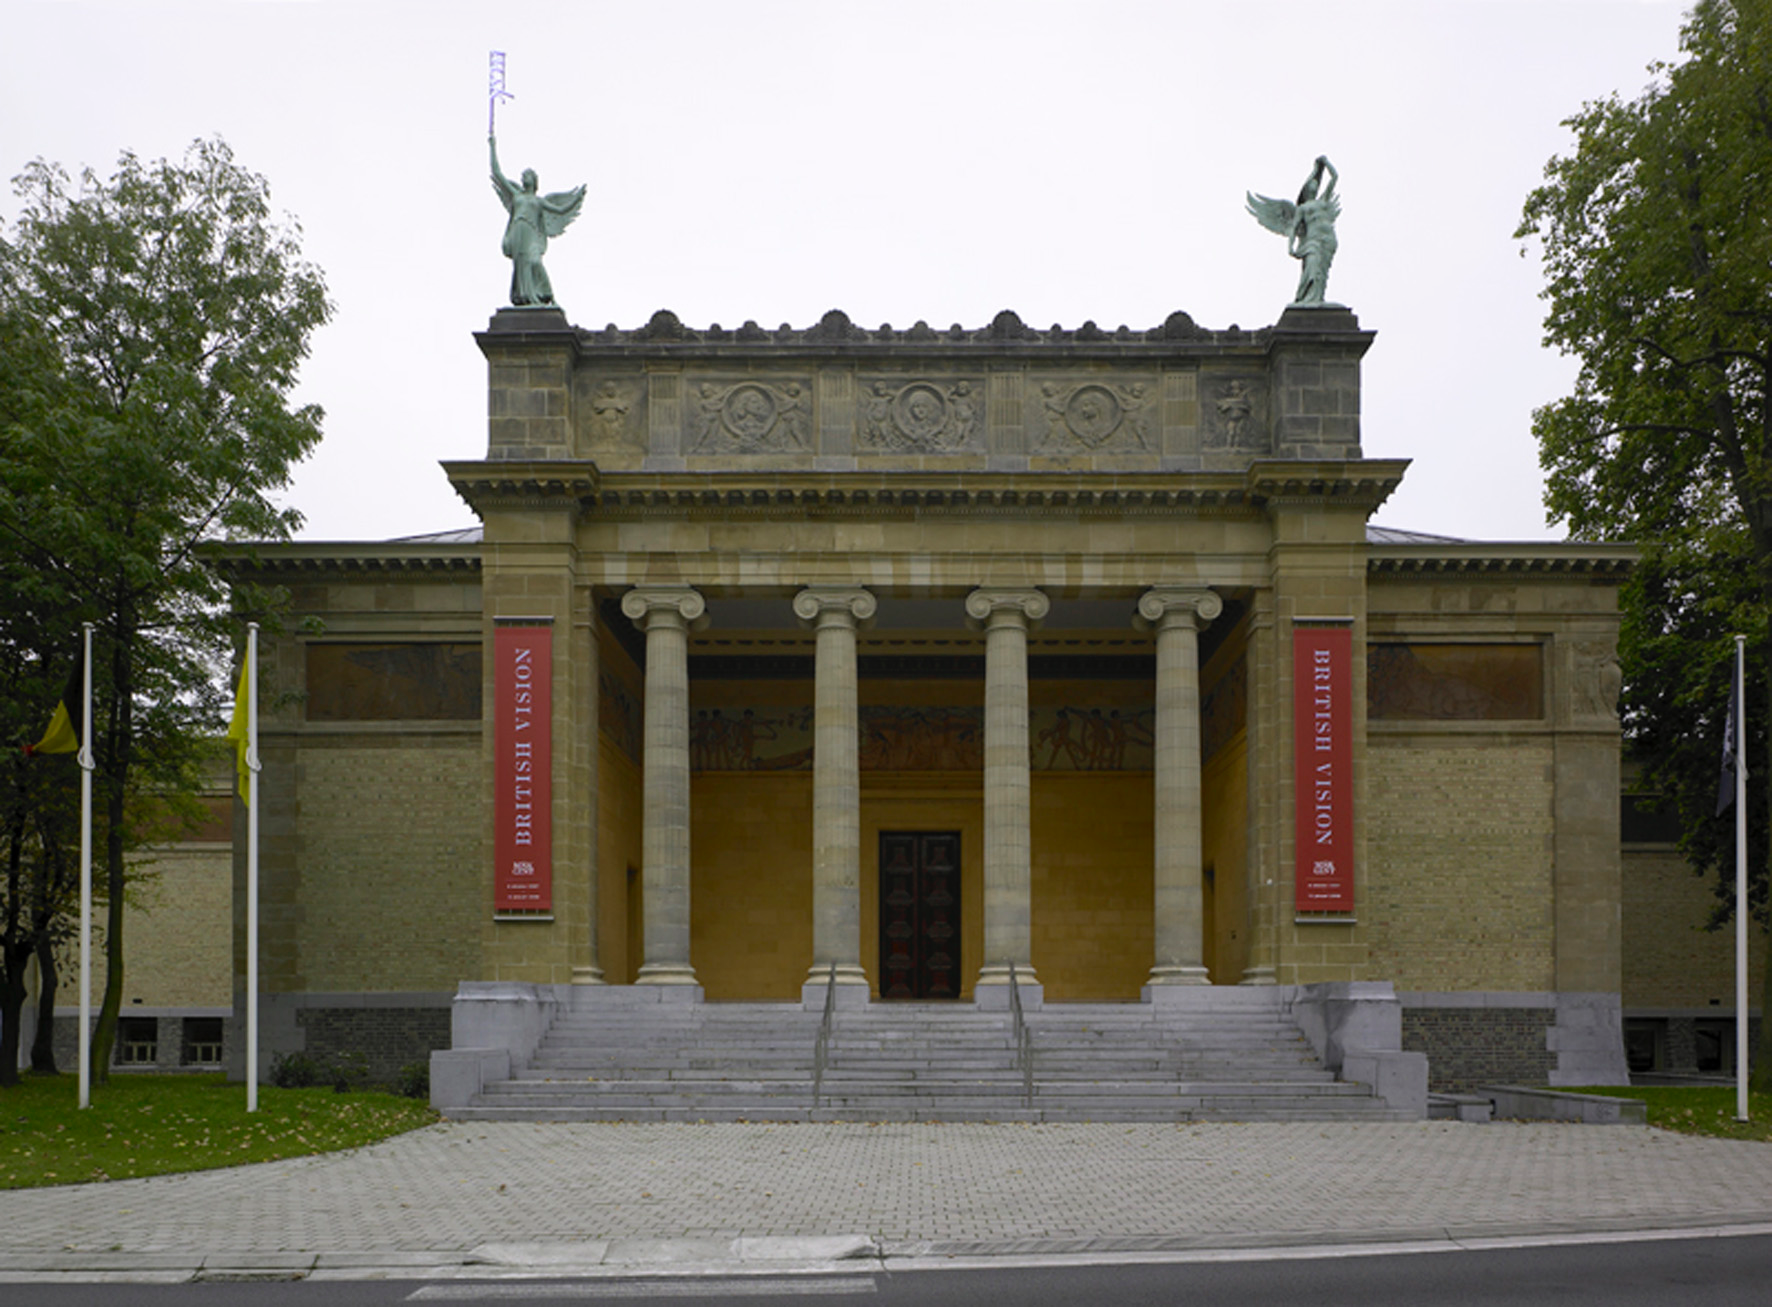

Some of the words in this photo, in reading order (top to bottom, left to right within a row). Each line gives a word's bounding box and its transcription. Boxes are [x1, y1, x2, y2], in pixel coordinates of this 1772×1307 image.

[515, 648, 532, 731] VISION
[1314, 650, 1332, 751] BRITISH
[515, 742, 532, 845] BRITISH
[1315, 763, 1332, 845] VISION
